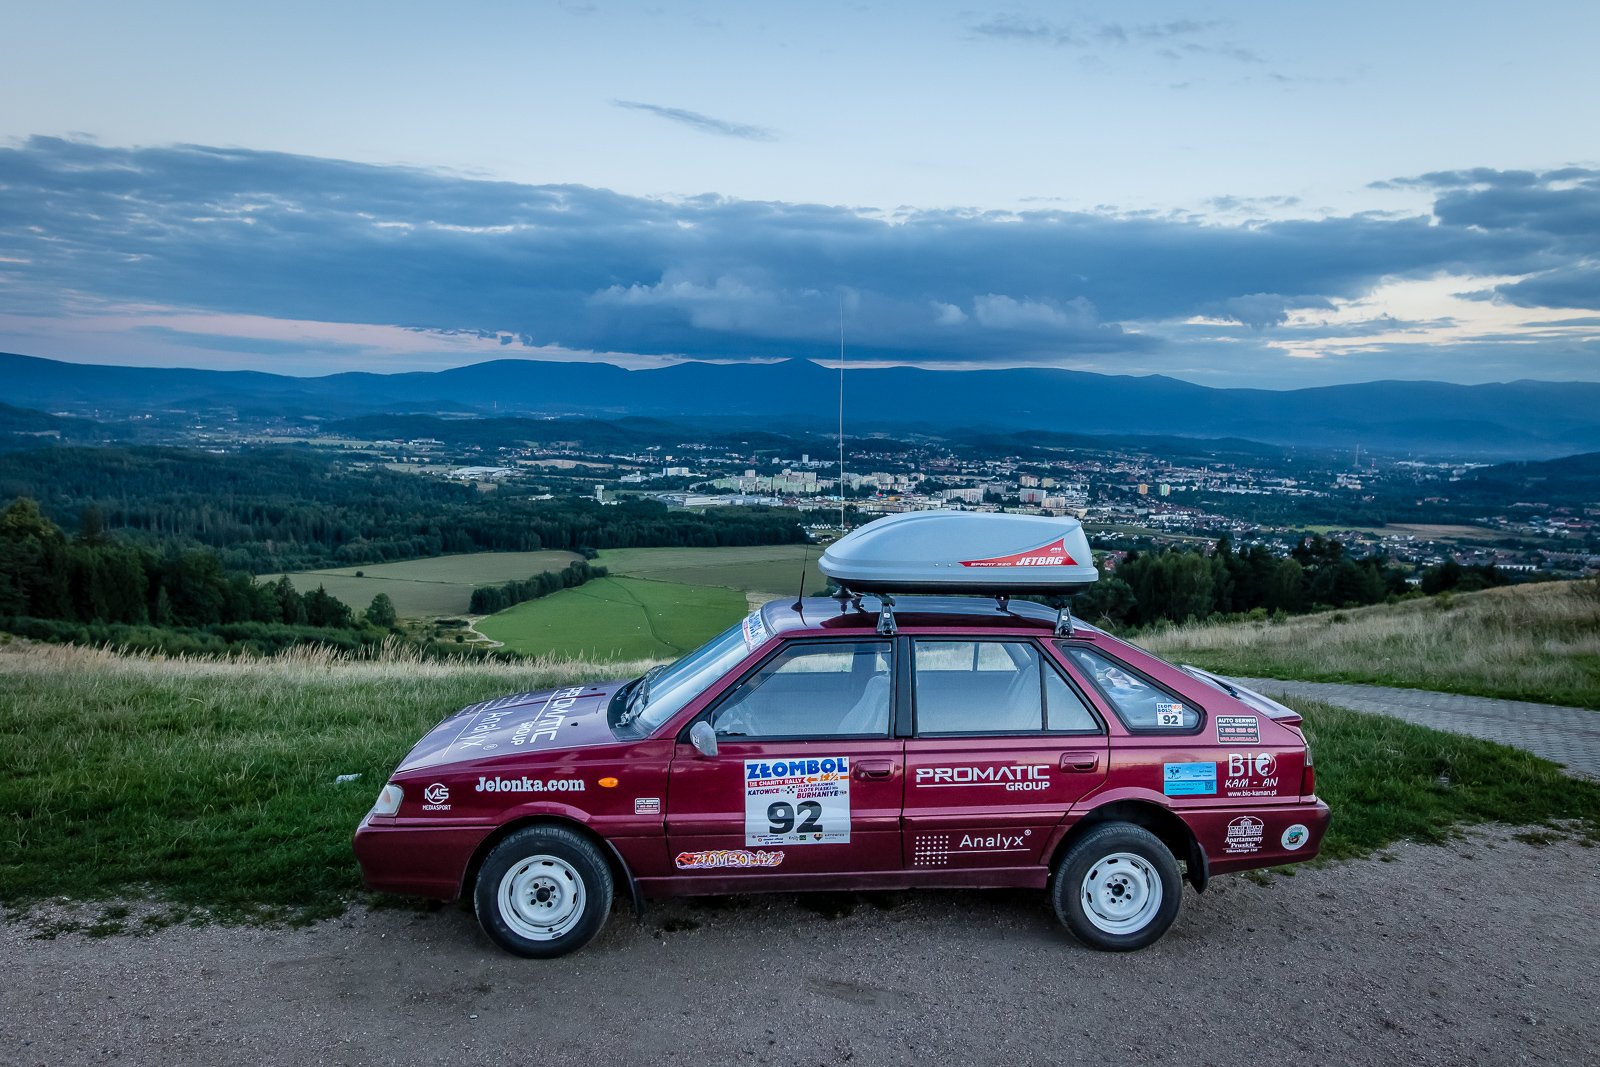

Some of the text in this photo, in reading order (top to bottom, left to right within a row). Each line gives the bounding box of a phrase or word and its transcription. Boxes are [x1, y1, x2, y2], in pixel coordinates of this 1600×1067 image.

[1016, 557, 1064, 566] JETBAG
[1162, 714, 1179, 725] 92
[747, 758, 847, 779] ZŁOMBOL
[915, 765, 1050, 783] PROMATIC
[475, 776, 585, 792] Jelonka.com
[1005, 781, 1050, 791] GROUP
[1225, 778, 1249, 788] KAM
[1262, 777, 1279, 787] AN
[748, 788, 780, 796] KATOWICE
[796, 790, 839, 799] BURHANIYE
[1227, 789, 1277, 797] www.bio-kaman.pl
[766, 800, 823, 834] 92
